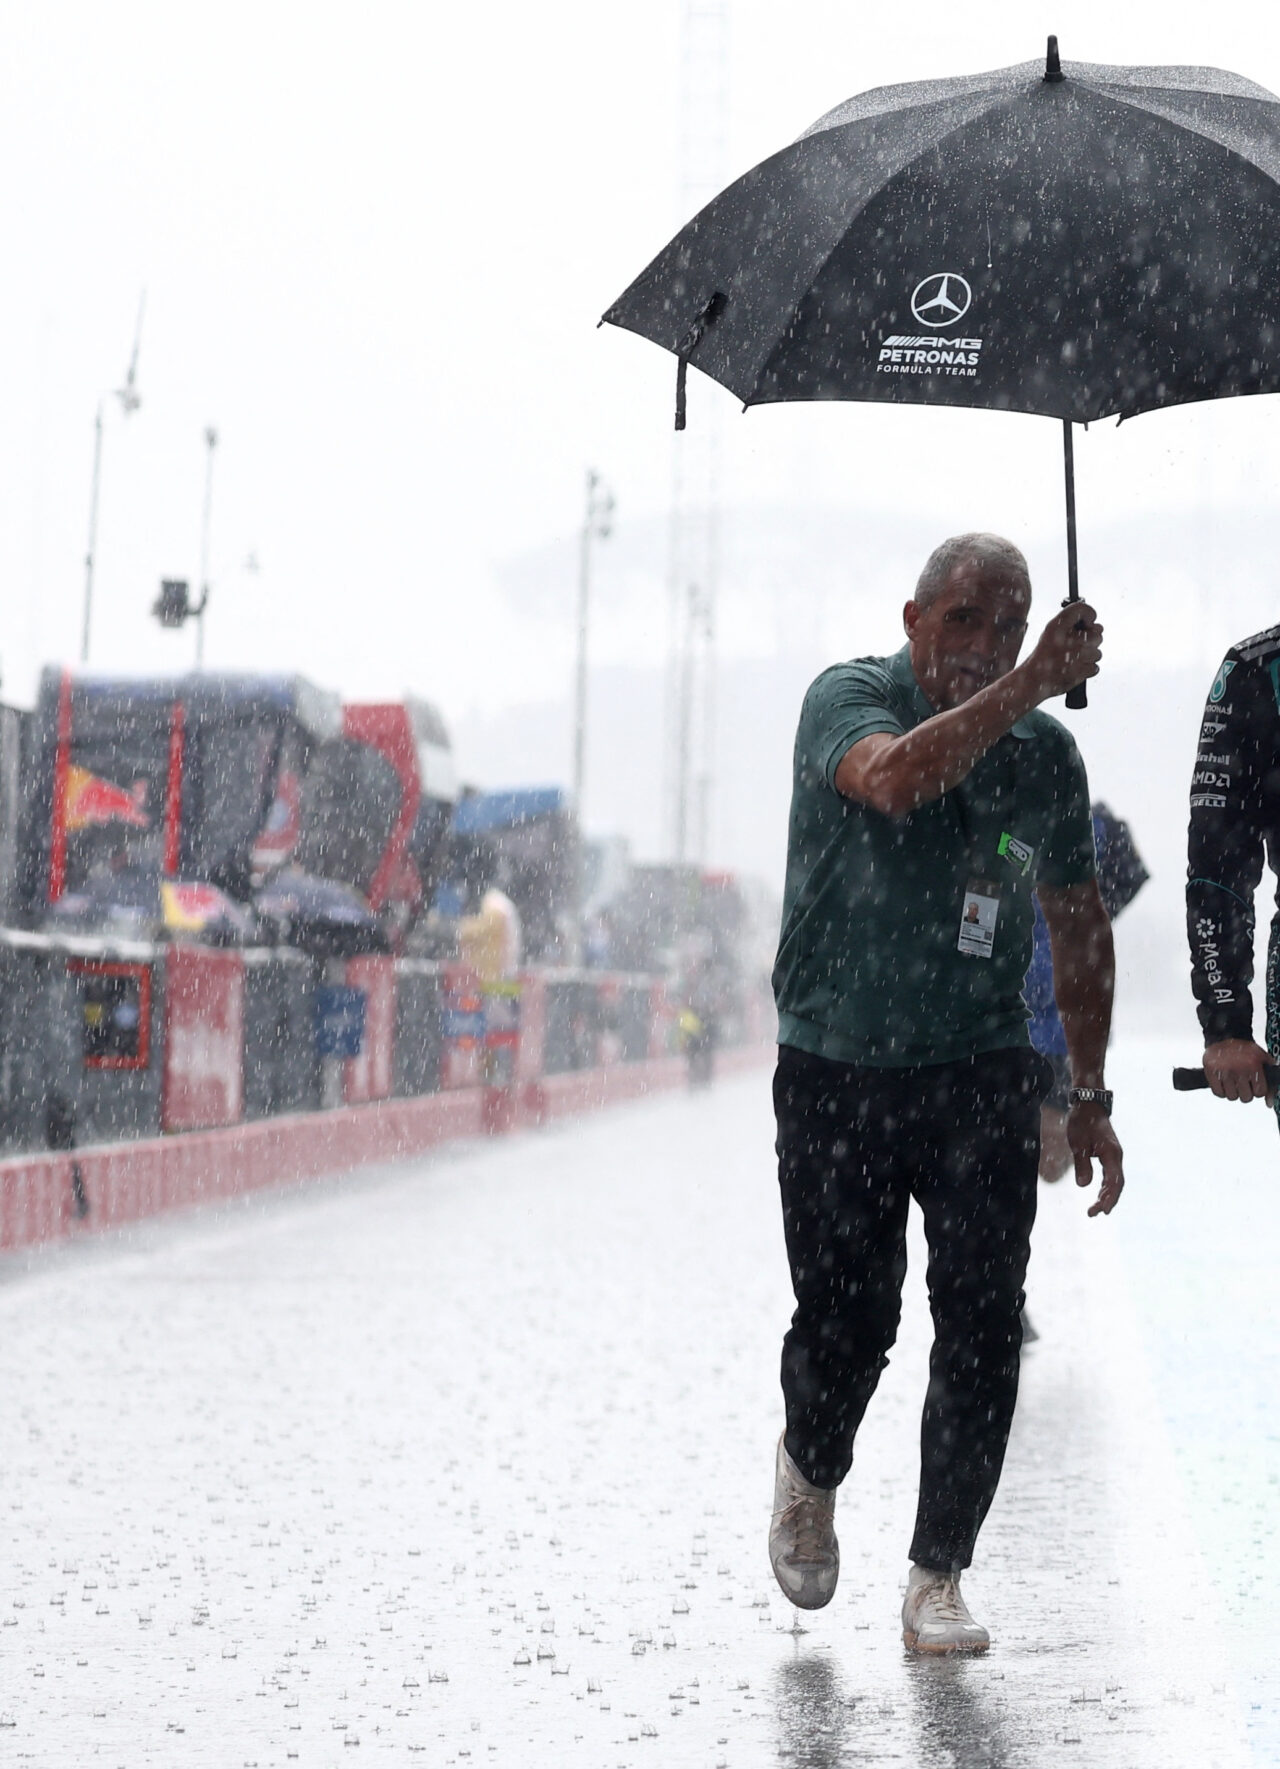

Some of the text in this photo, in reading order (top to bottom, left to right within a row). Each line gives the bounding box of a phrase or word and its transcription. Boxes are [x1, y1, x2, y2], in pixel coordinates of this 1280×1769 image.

[914, 336, 983, 350] AMG
[878, 349, 980, 366] PETRONAS
[876, 365, 977, 377] FORMULA 1 TEAM
[1199, 942, 1235, 1004] Meta AI
